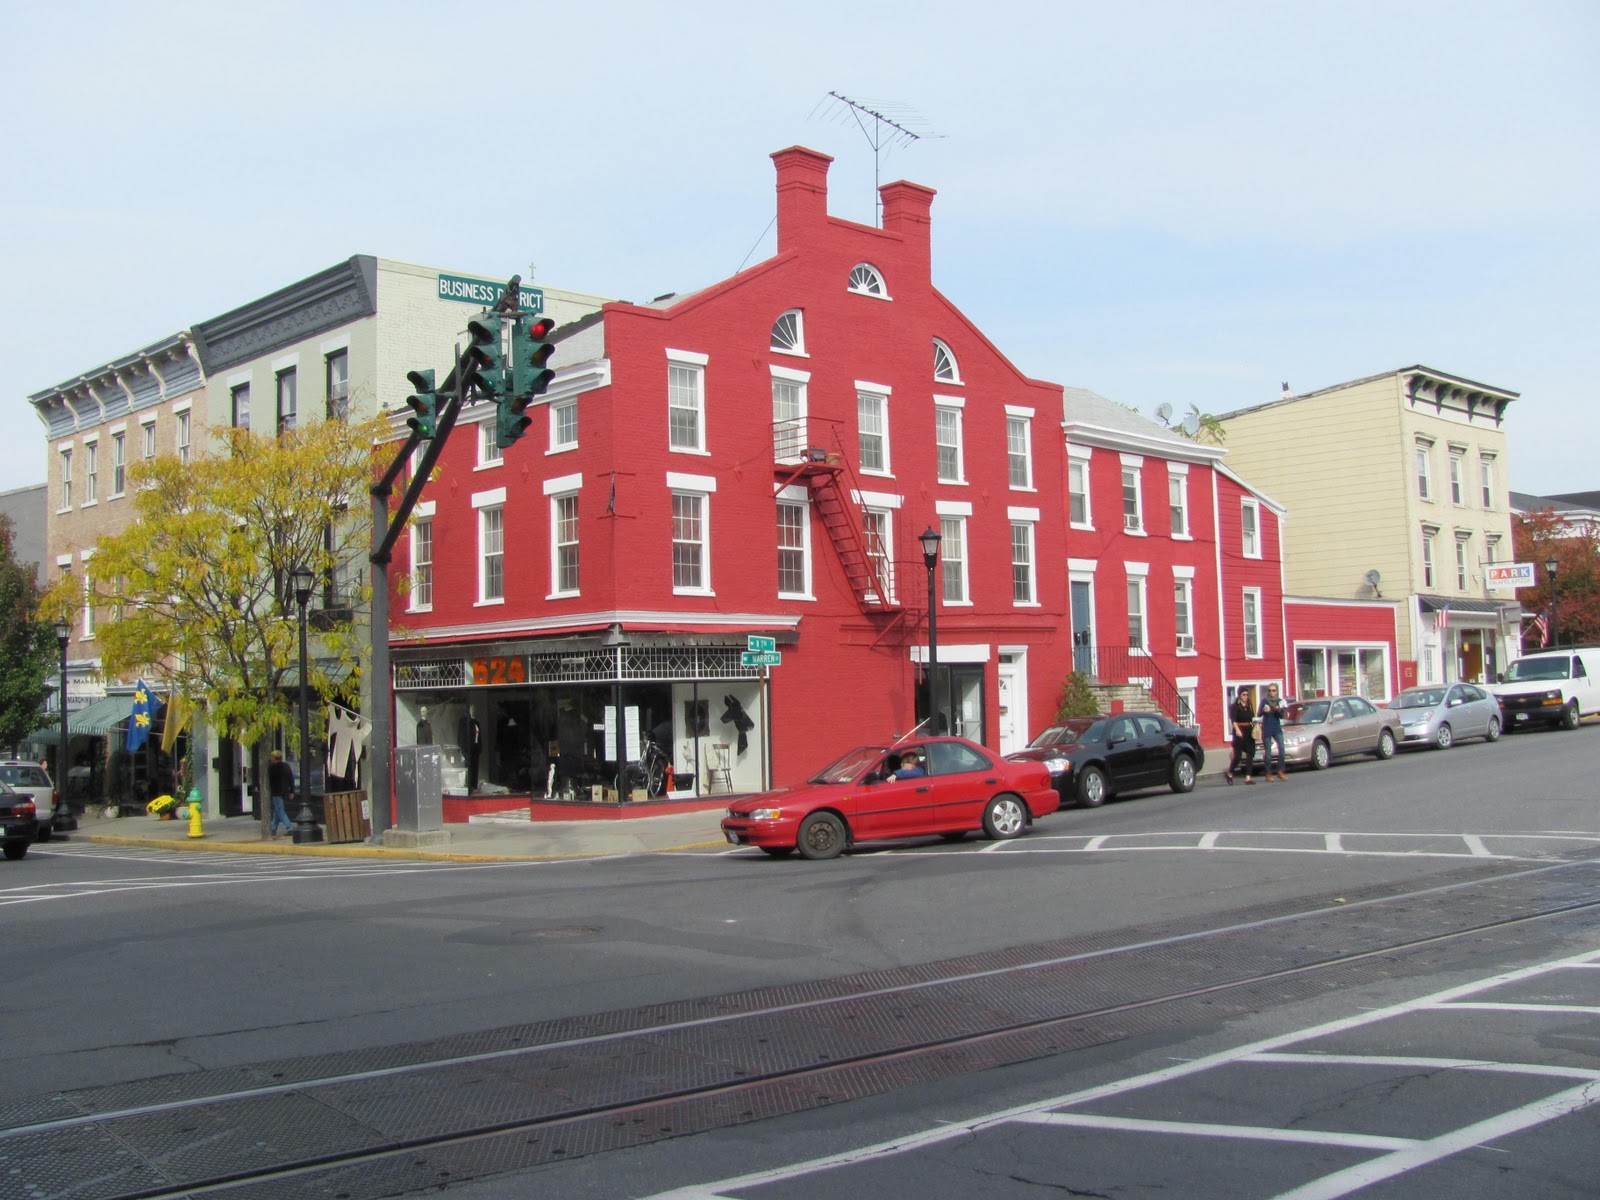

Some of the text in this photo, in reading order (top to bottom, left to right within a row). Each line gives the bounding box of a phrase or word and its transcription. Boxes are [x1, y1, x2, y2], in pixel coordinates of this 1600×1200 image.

[440, 279, 542, 309] BUSINESS DRICT
[1490, 567, 1529, 579] PARK
[752, 654, 775, 663] WARREN
[472, 655, 525, 685] 624
